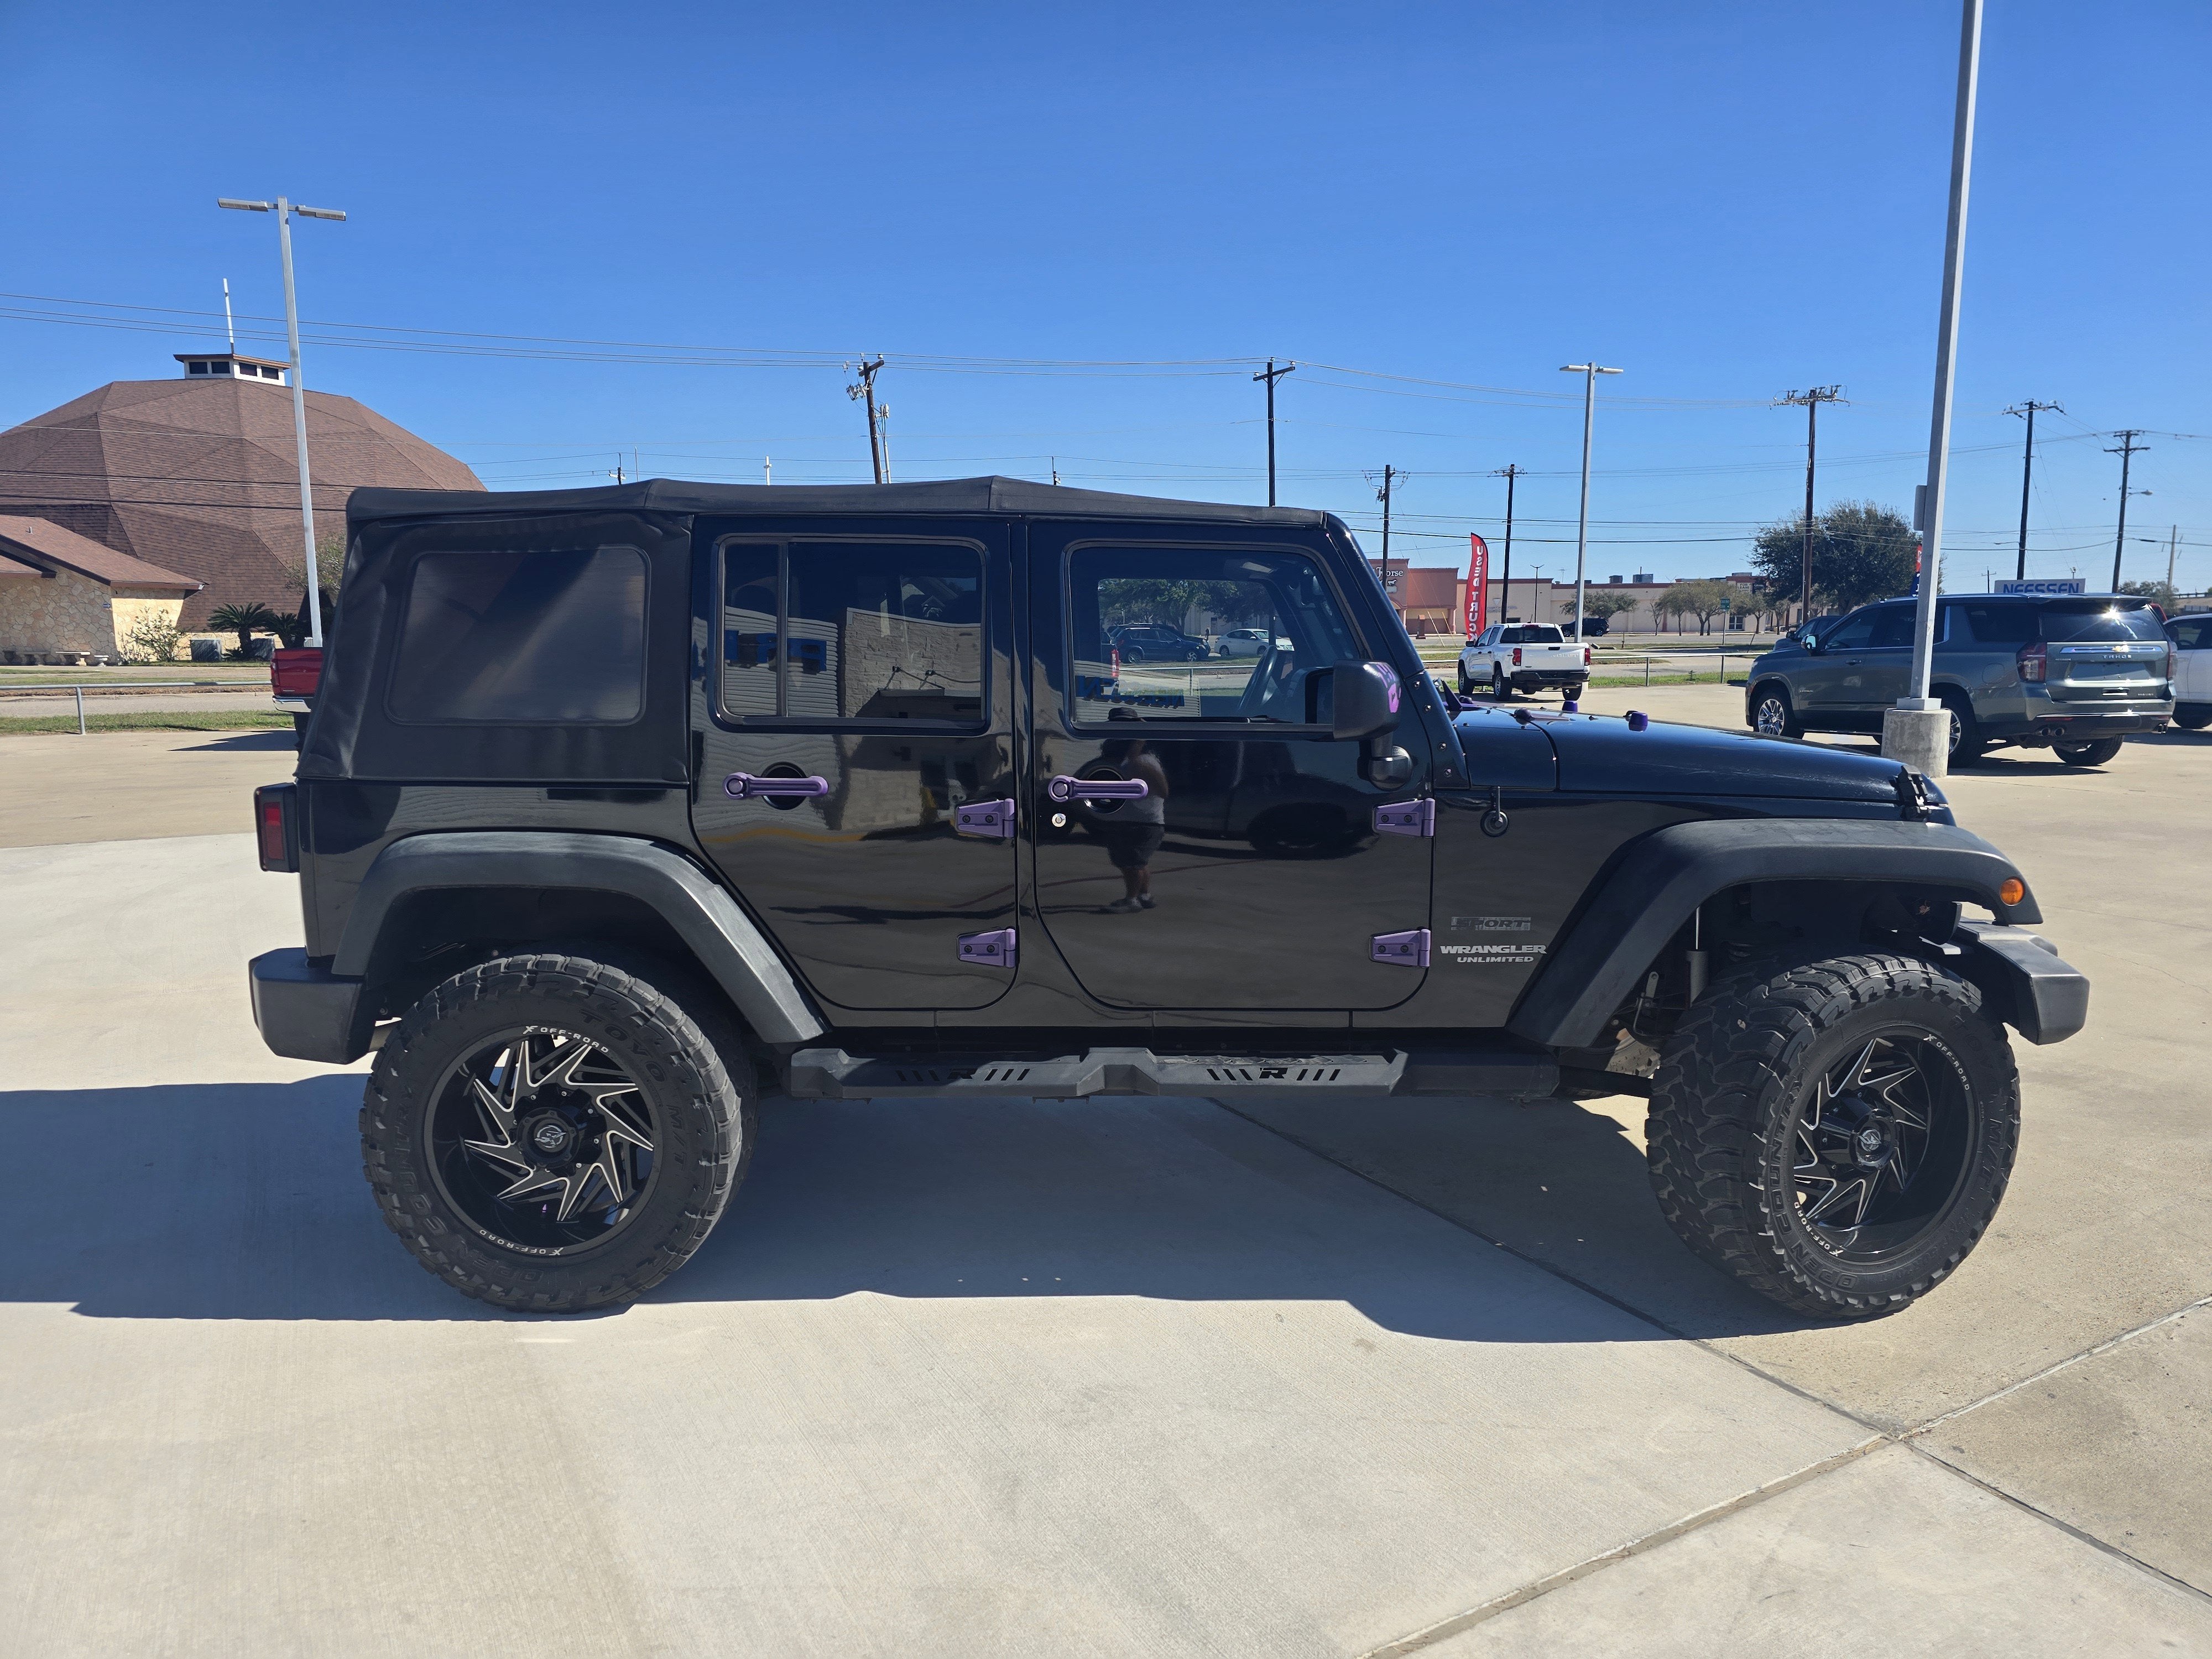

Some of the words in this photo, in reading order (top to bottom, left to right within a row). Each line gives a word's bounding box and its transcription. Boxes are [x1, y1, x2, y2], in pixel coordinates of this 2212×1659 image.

[1440, 945, 1547, 954] WRANGLER
[540, 1027, 609, 1053] OFF-ROAD
[1936, 1041, 1970, 1091] OFF-ROAD
[1794, 1202, 1830, 1250] OFF-ROAD
[479, 1229, 546, 1254] OFF-ROAD
